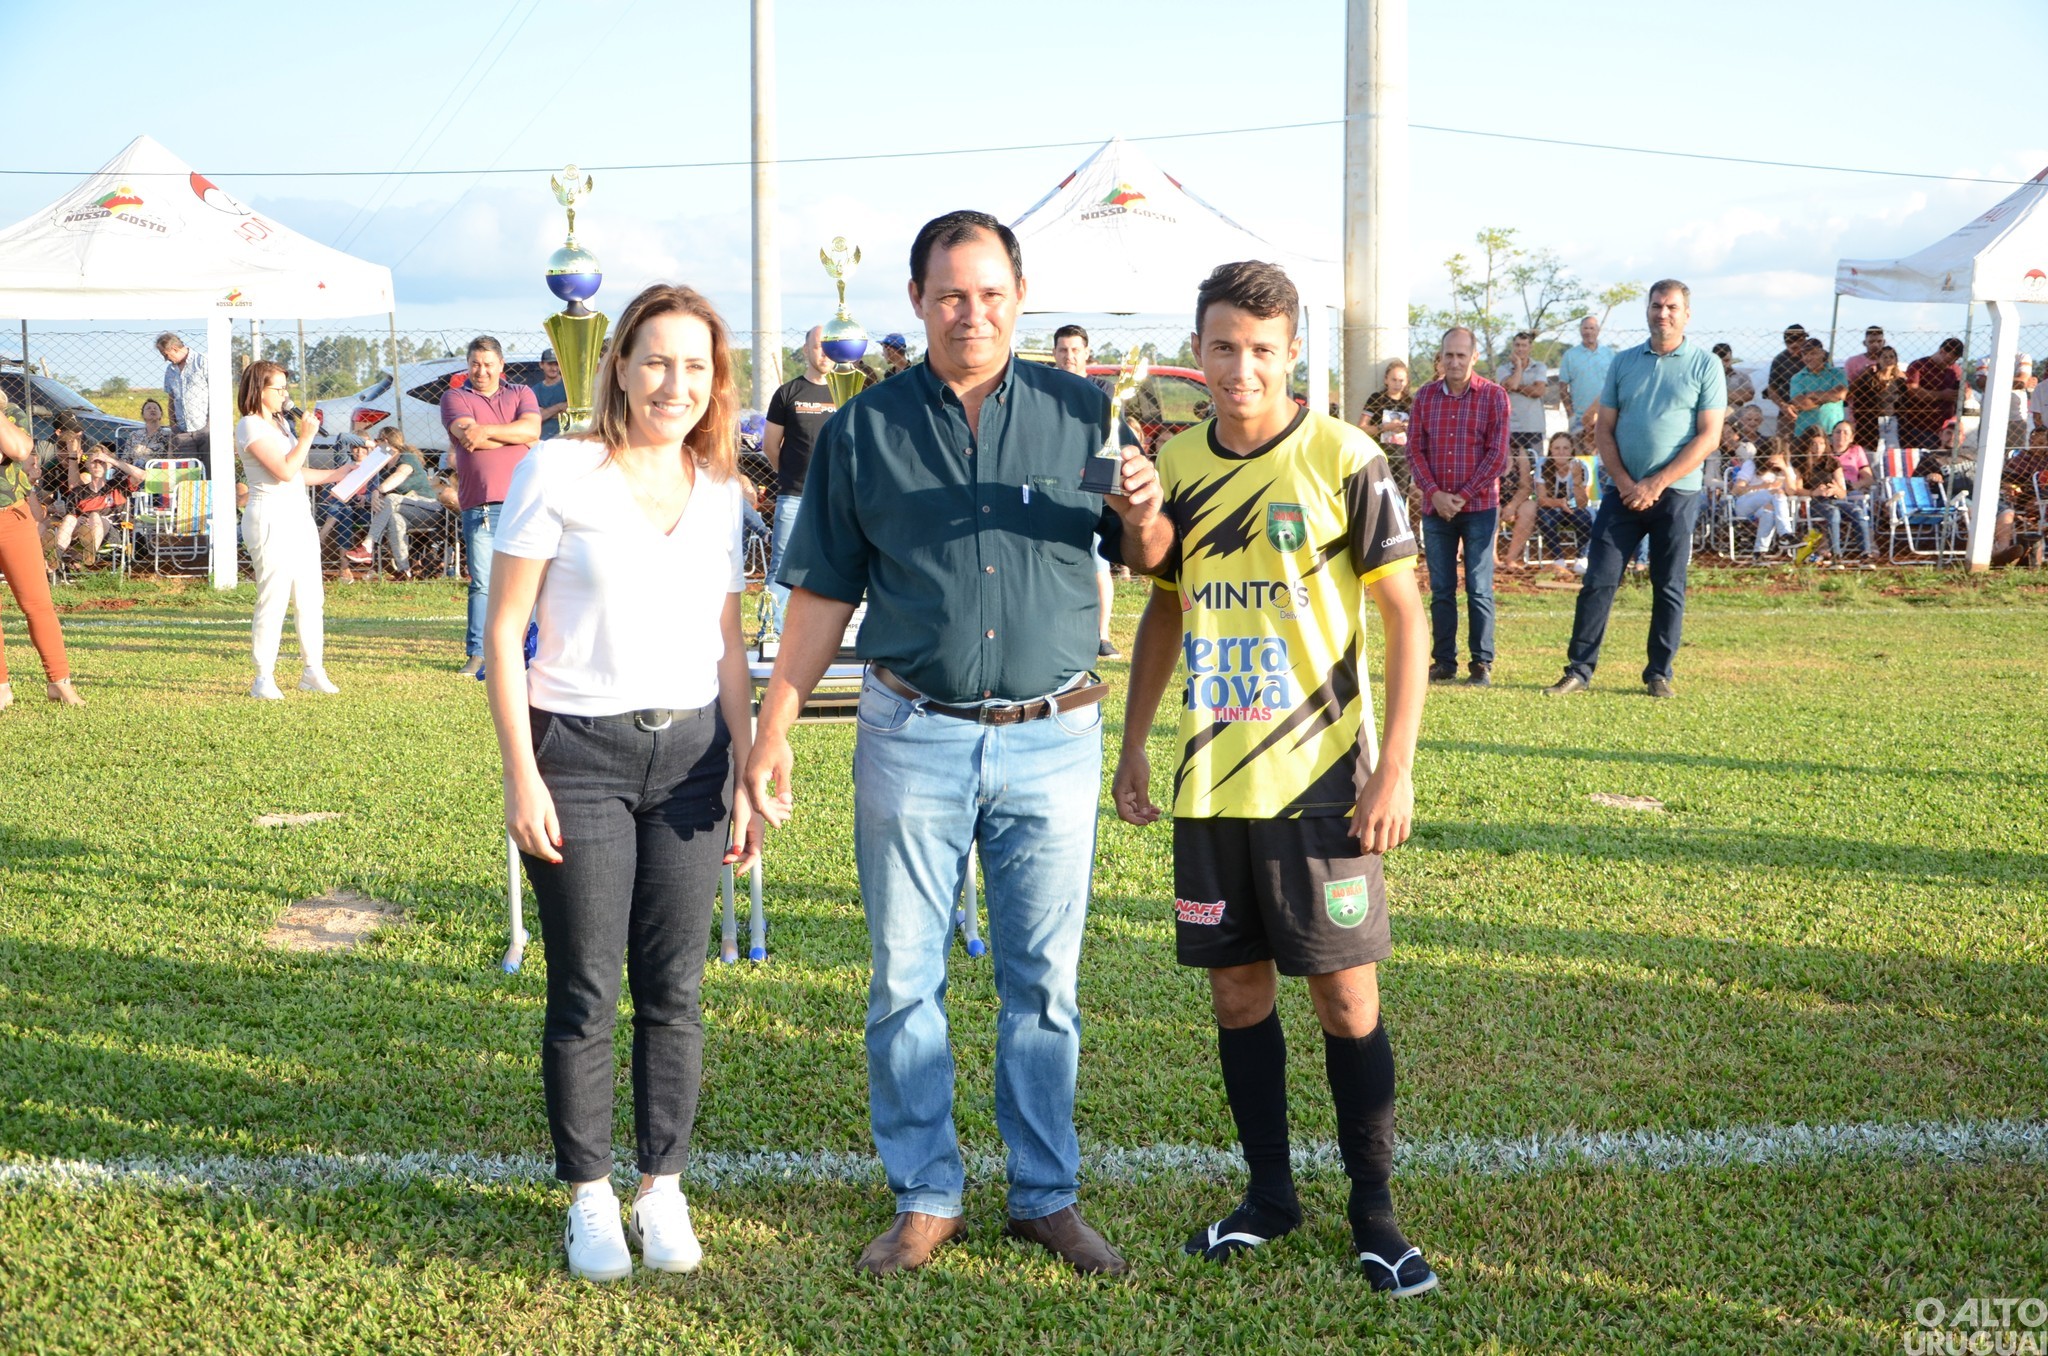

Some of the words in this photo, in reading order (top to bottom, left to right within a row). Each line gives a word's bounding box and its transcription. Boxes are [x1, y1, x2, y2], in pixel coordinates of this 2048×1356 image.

[64, 210, 112, 223] NOSSO
[115, 212, 167, 233] GOSTO
[1081, 207, 1127, 221] NOSSO
[1192, 581, 1309, 609] MINTO'S
[1212, 706, 1272, 721] TINTAS
[1178, 912, 1220, 924] MOTOS
